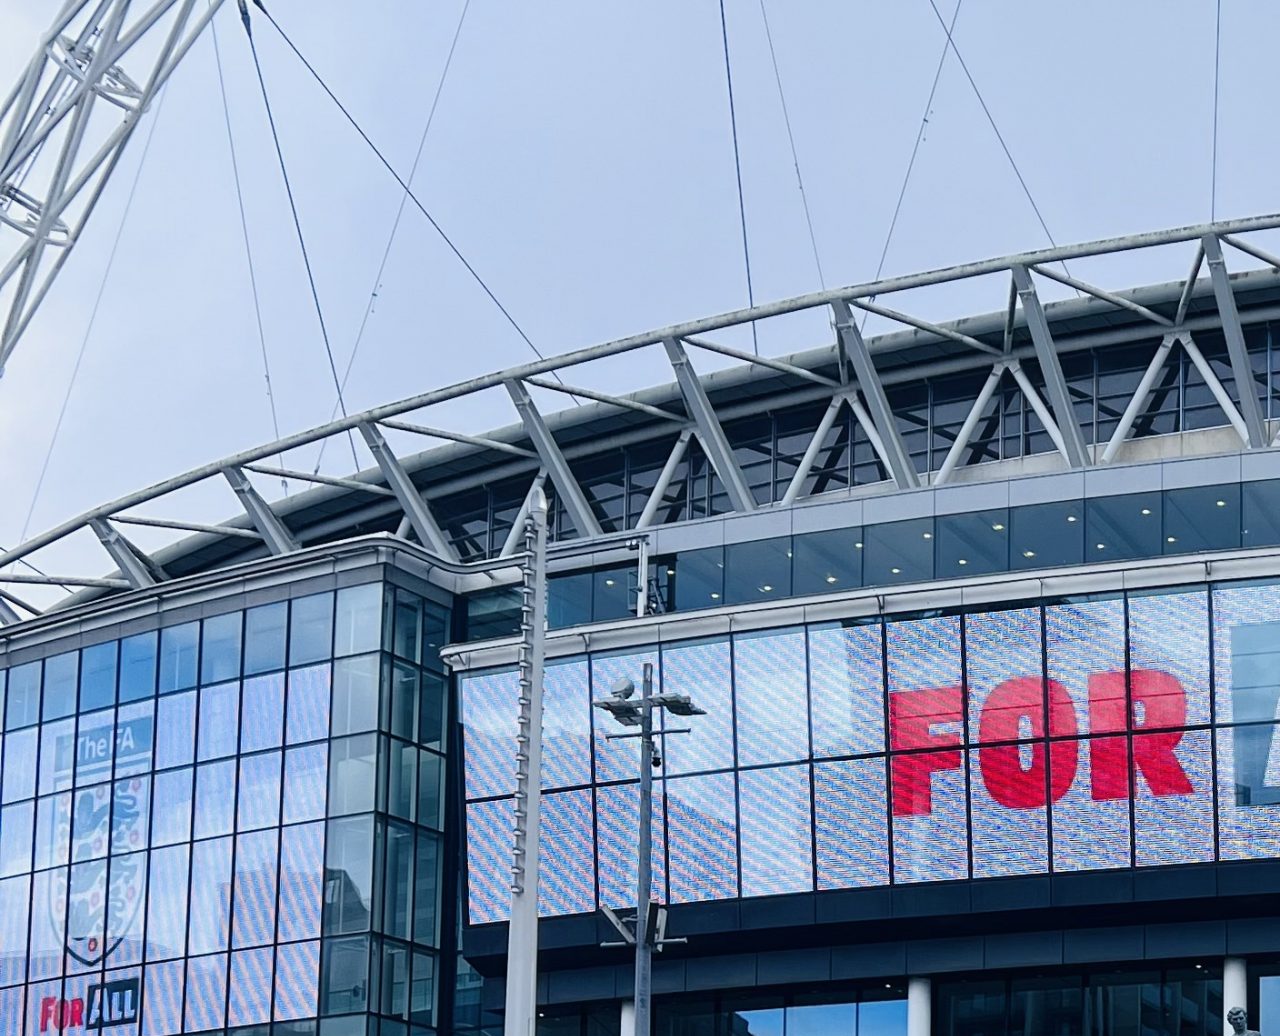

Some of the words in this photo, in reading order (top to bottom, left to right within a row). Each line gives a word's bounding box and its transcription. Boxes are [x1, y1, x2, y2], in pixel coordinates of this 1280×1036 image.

[75, 734, 106, 761] The
[109, 726, 135, 754] FA
[889, 668, 1194, 817] FOR
